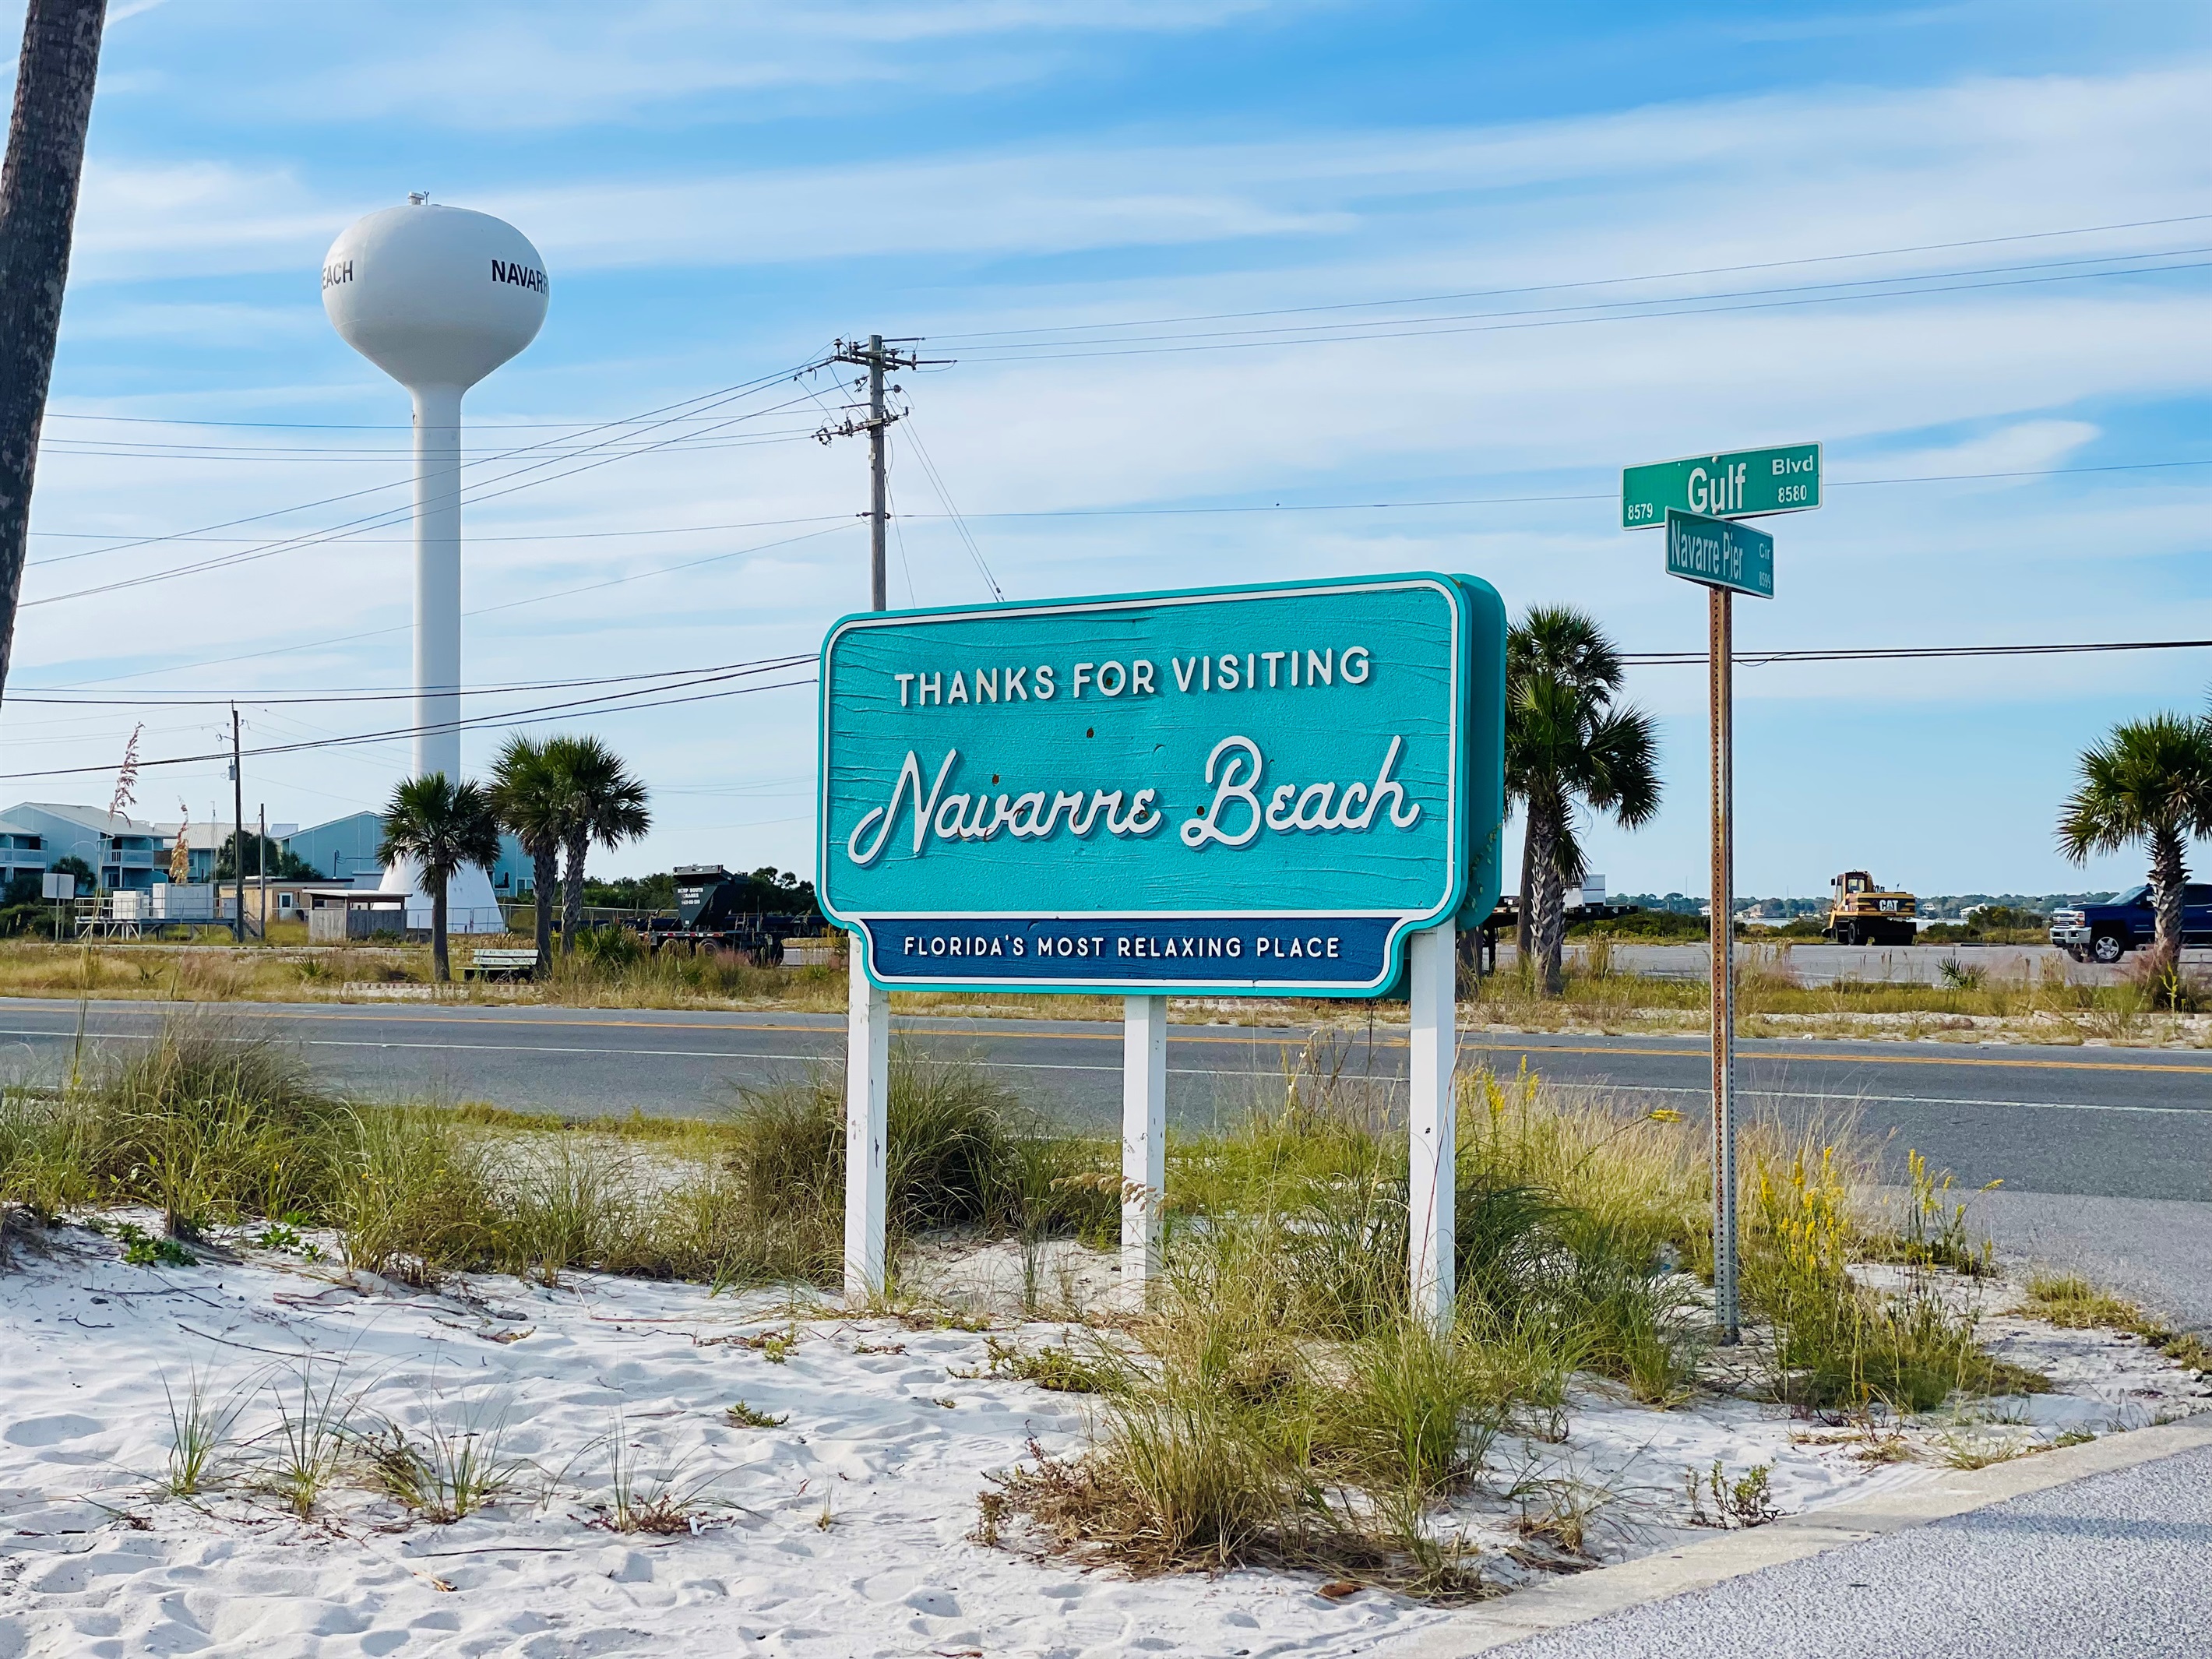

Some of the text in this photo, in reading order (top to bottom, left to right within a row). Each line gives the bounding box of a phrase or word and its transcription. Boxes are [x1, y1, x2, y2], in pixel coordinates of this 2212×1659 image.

[1628, 484, 1807, 520] 8579 8580
[1688, 455, 1813, 513] Gulf Blvd
[1671, 520, 1770, 580] Navarre Pier Cir
[895, 646, 1369, 706] THANKS FOR VISITING
[848, 735, 1421, 867] Navarre Beach
[1879, 900, 1898, 911] CAT
[904, 935, 1339, 957] FLORIDA'S MOST RELAXING PLACE
